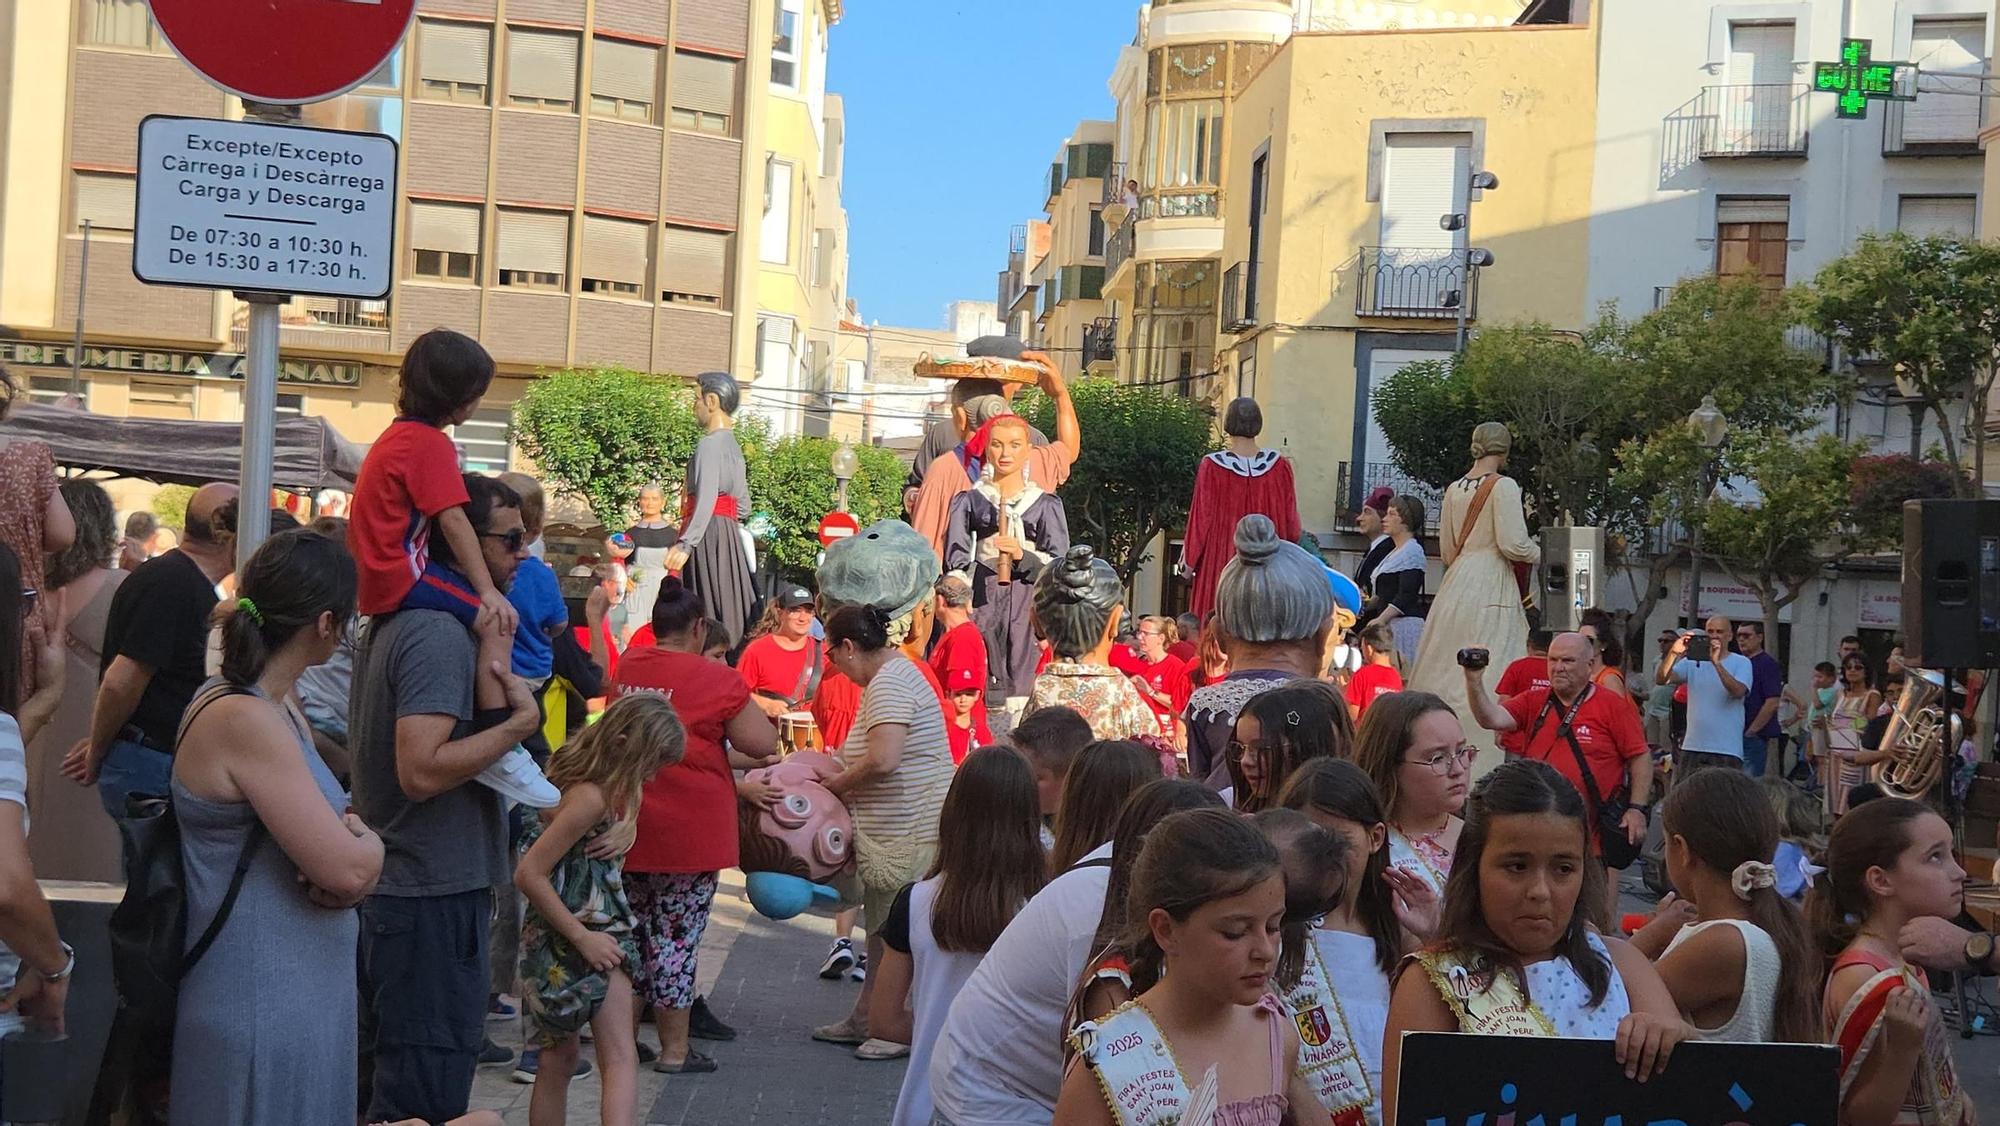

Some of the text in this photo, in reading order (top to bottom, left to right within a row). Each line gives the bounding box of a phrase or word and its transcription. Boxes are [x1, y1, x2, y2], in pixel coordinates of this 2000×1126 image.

[187, 134, 363, 167] Excepte/Excepto
[162, 154, 385, 193] Càrrega i Descàrrega
[178, 179, 366, 214] Carga y Descarga
[170, 225, 369, 258] De 07:30 a 10:30 h.
[169, 248, 366, 280] De 15:30 a 17:30 h.
[230, 356, 360, 384] ANAU
[1475, 1014, 1492, 1032] FIRA
[1495, 1005, 1526, 1017] FESTES
[1506, 1015, 1527, 1024] JOAN
[1106, 1031, 1143, 1057] 2025
[1117, 1082, 1137, 1102] FIRA
[1140, 1069, 1175, 1084] FESTES
[1127, 1083, 1174, 1110] SANT JOAN
[1320, 1080, 1355, 1097] ORTEGA
[1136, 1098, 1181, 1124] SANT PERE
